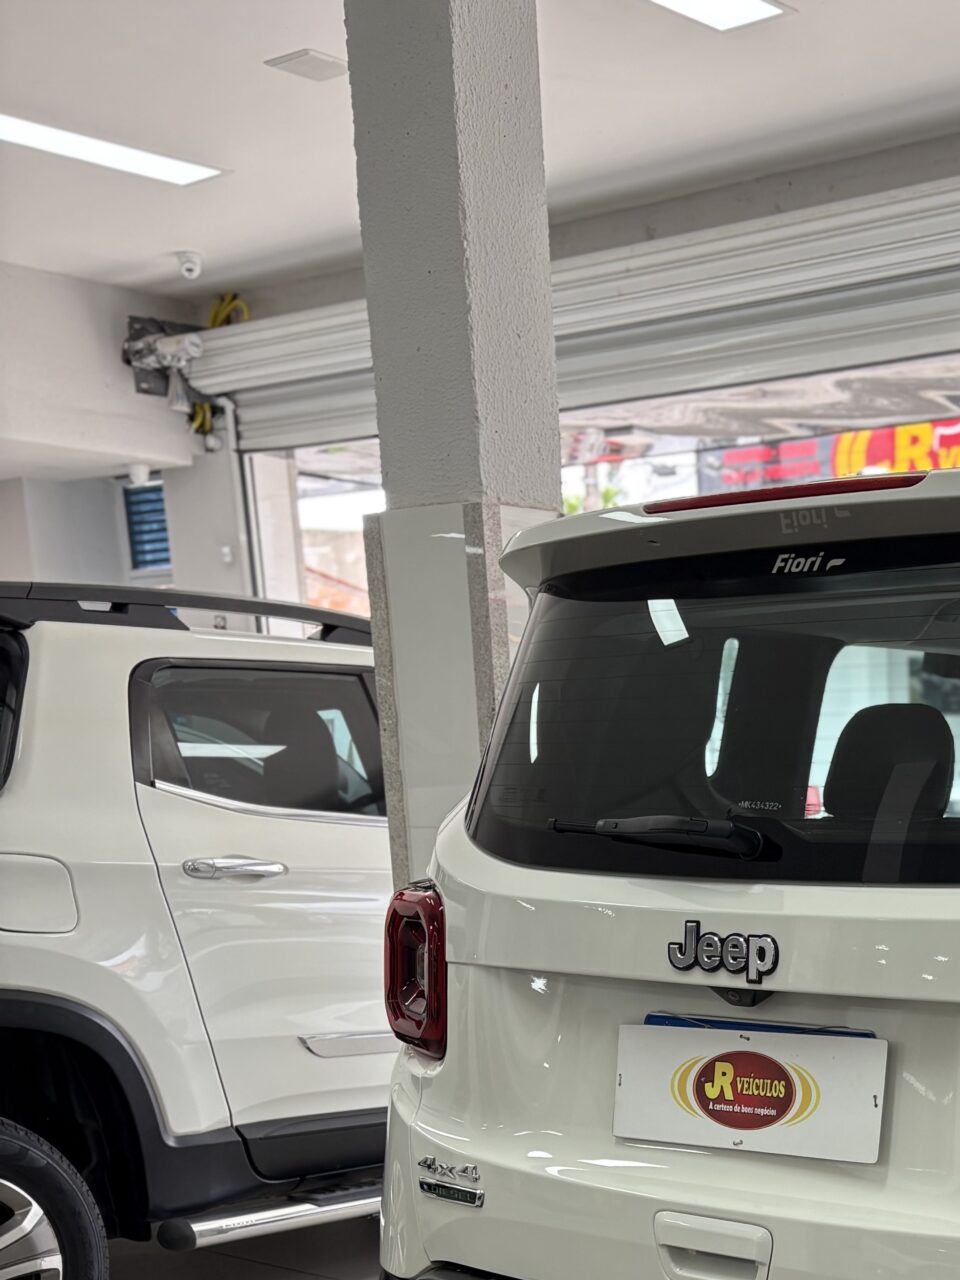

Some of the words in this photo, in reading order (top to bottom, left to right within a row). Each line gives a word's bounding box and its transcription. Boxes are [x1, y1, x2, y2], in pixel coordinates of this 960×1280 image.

[772, 551, 825, 574] Fiori
[668, 919, 780, 984] Jeep
[704, 1061, 734, 1101] JR
[736, 1073, 786, 1098] VEÍCULOS
